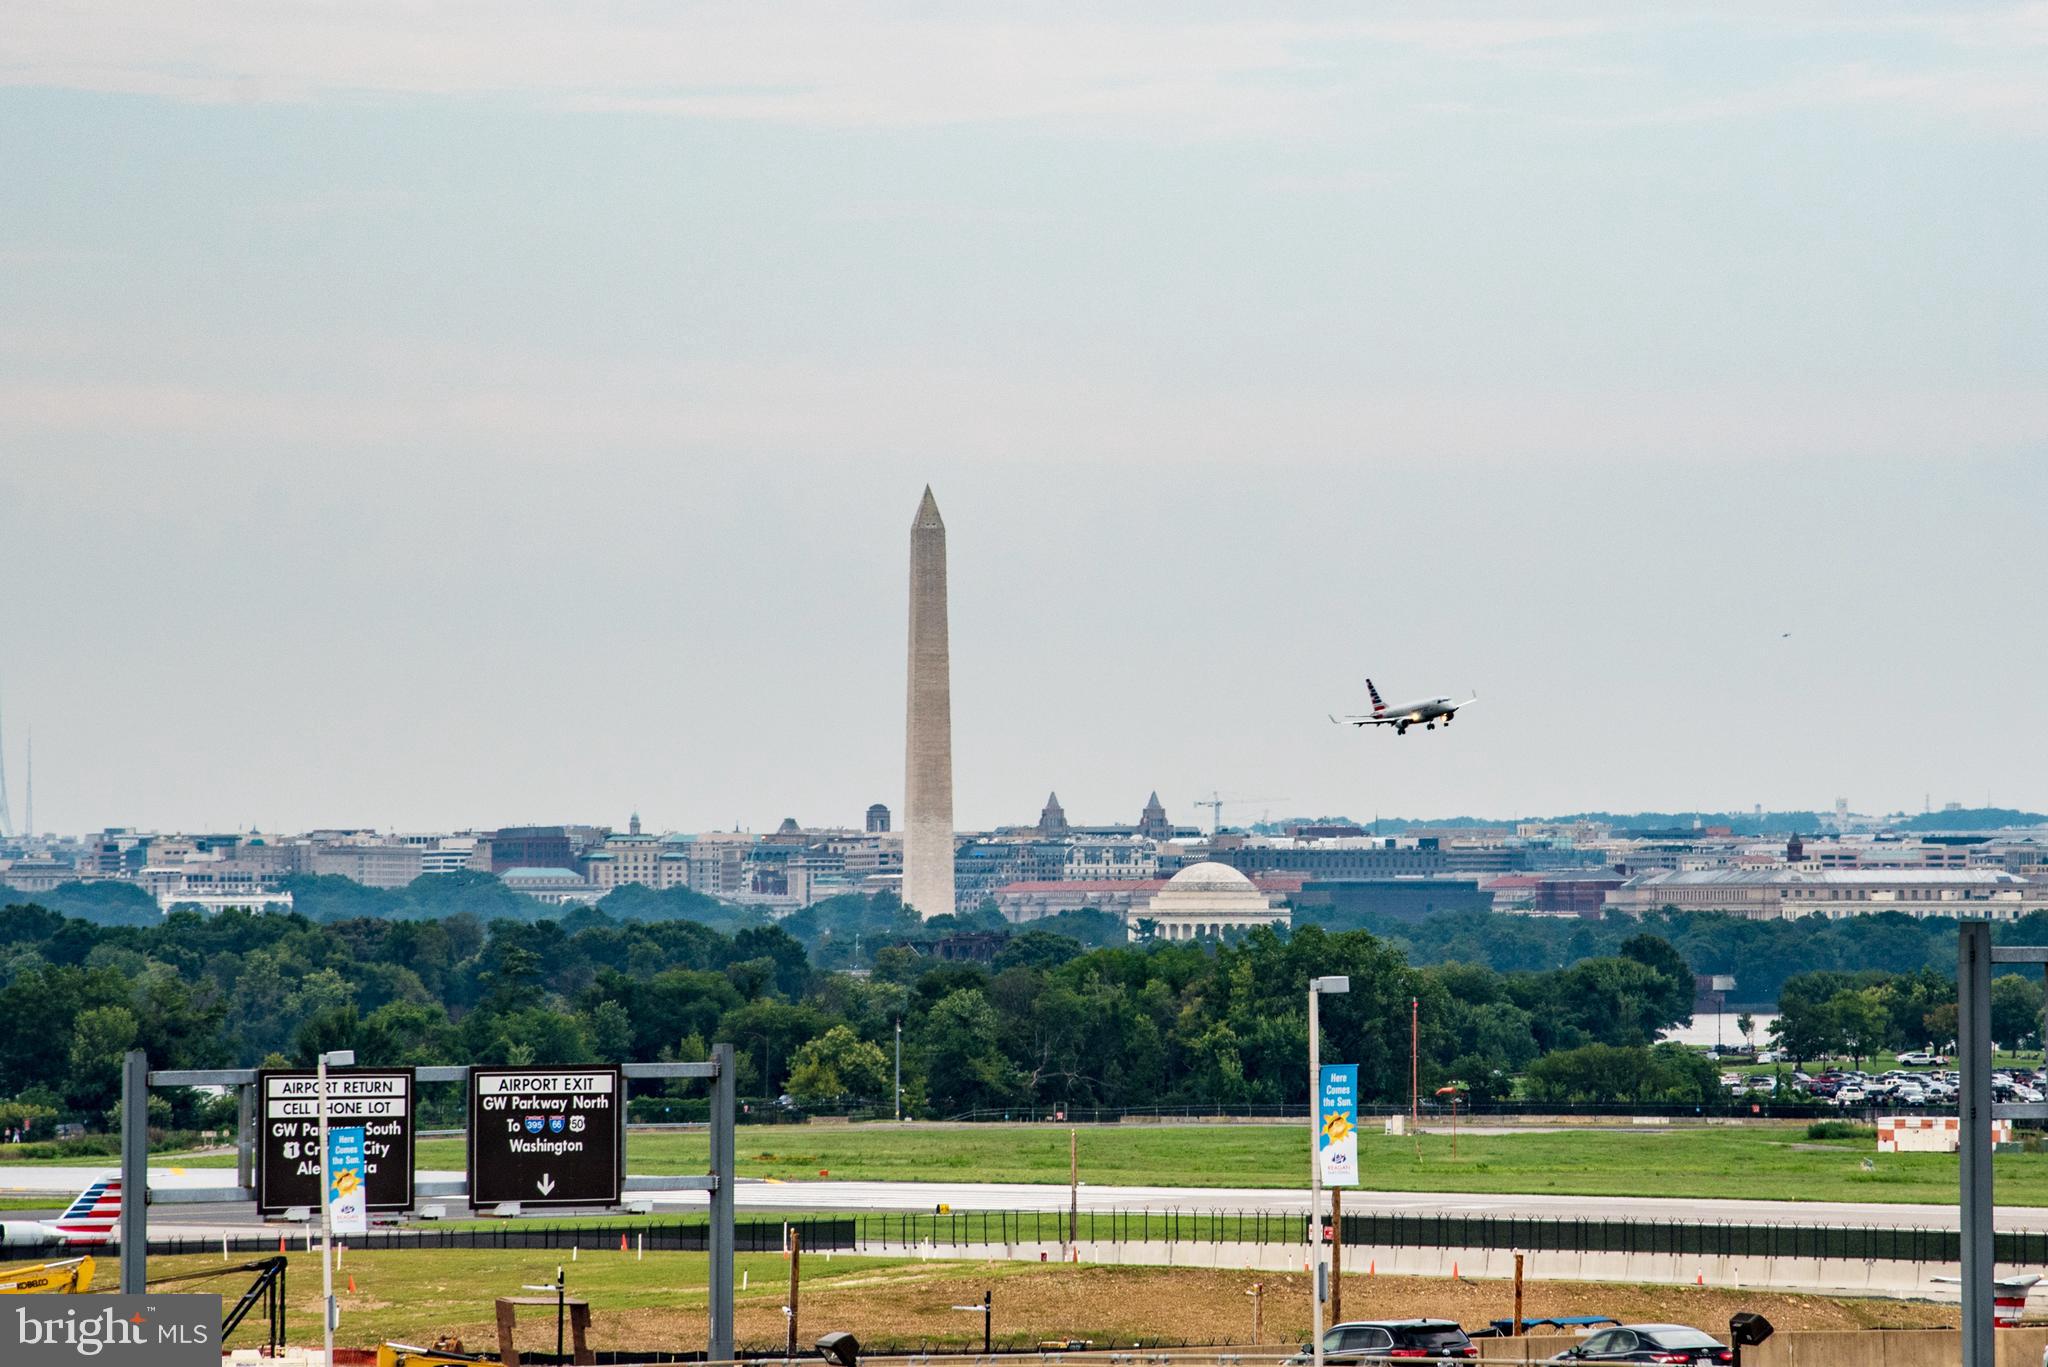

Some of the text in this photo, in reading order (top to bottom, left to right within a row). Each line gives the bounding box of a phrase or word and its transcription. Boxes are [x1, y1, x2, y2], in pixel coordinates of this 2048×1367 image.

[498, 1078, 594, 1091] AIRPORT EXIT
[1331, 1073, 1347, 1083] Here
[343, 1081, 393, 1093] RETURN
[1326, 1085, 1351, 1095] Comes
[283, 1103, 311, 1115] CELL
[368, 1102, 391, 1114] LOT
[482, 1094, 609, 1112] GW Parkway North
[1323, 1097, 1353, 1107] the Sun.
[272, 1123, 298, 1137] GW
[365, 1120, 402, 1136] South
[506, 1118, 521, 1132] To
[552, 1120, 562, 1128] 66
[571, 1119, 583, 1129] 50
[363, 1141, 390, 1158] City
[509, 1138, 583, 1156] Washington
[16, 1278, 48, 1290] KOBELCO
